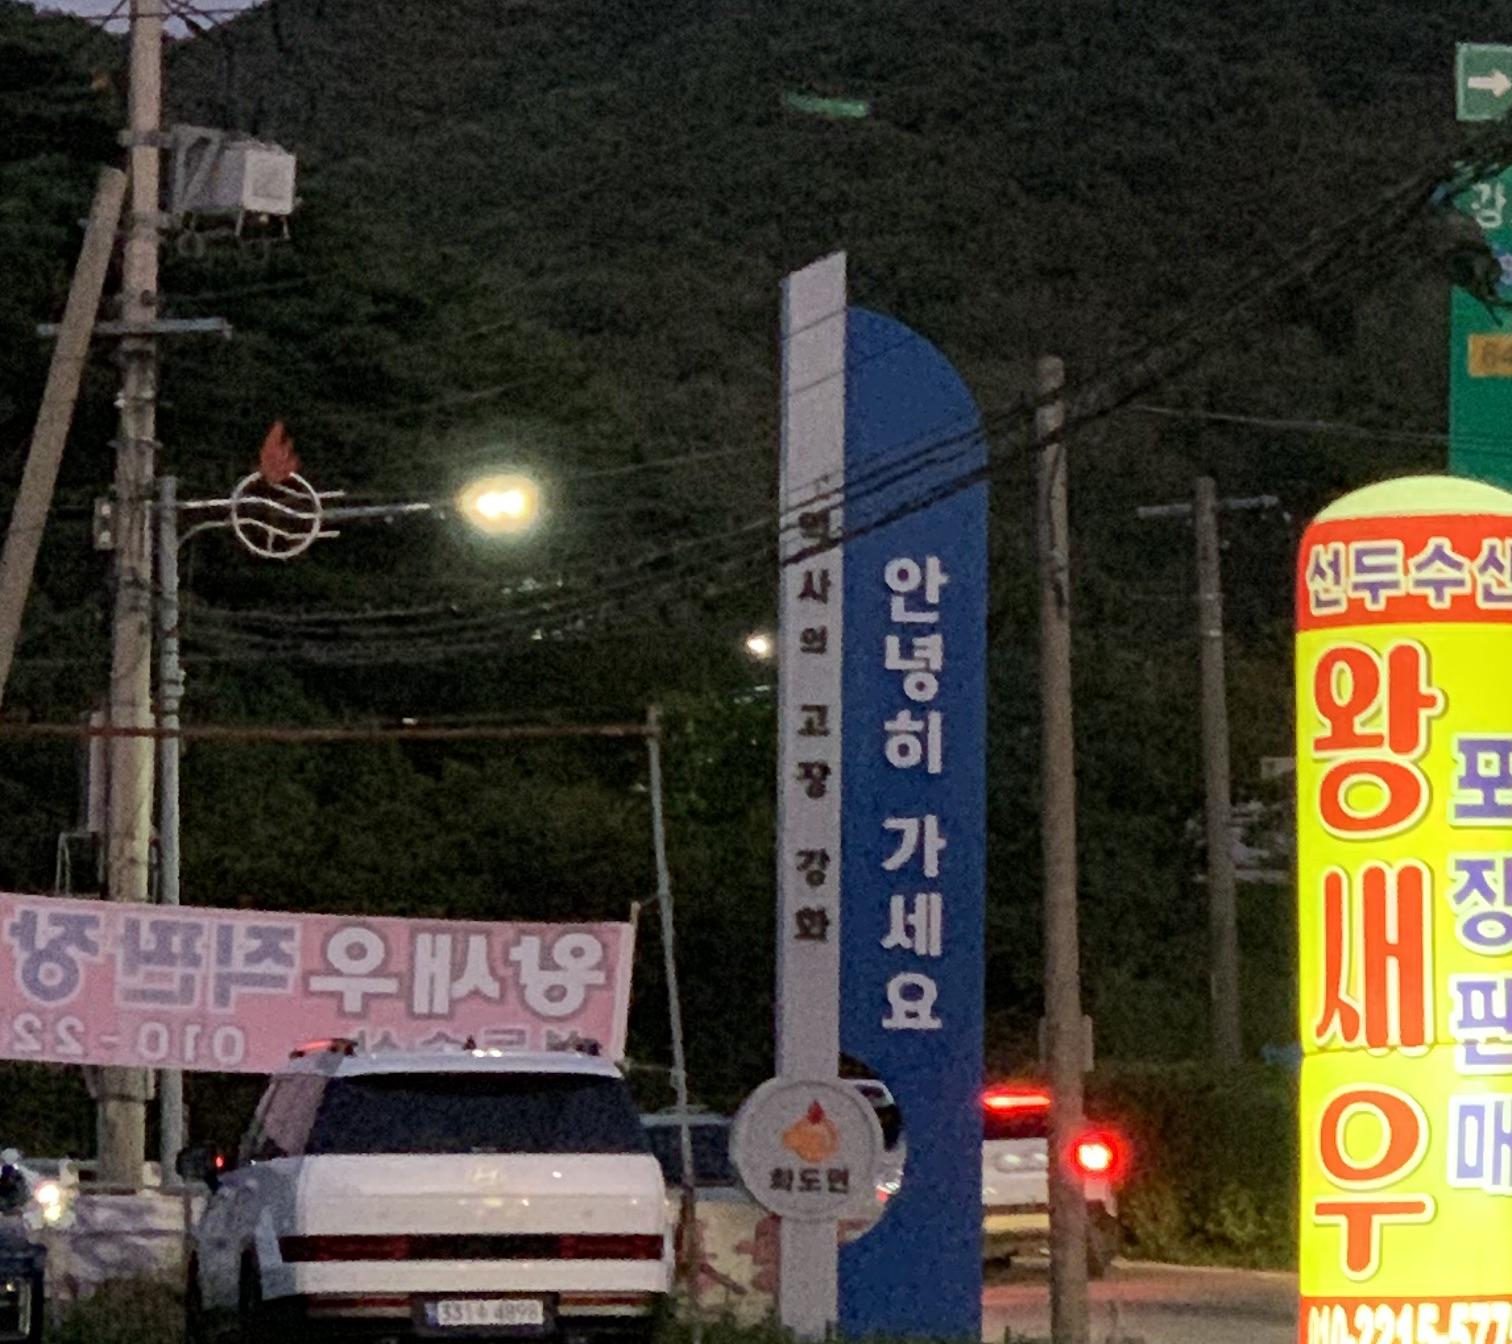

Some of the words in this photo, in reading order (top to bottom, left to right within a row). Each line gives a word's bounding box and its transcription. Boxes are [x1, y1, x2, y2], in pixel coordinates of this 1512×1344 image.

[884, 555, 949, 775] 안녕히
[880, 812, 947, 1031] 가세요
[1312, 640, 1447, 1282] 왕새우
[769, 1167, 850, 1194] 화도면
